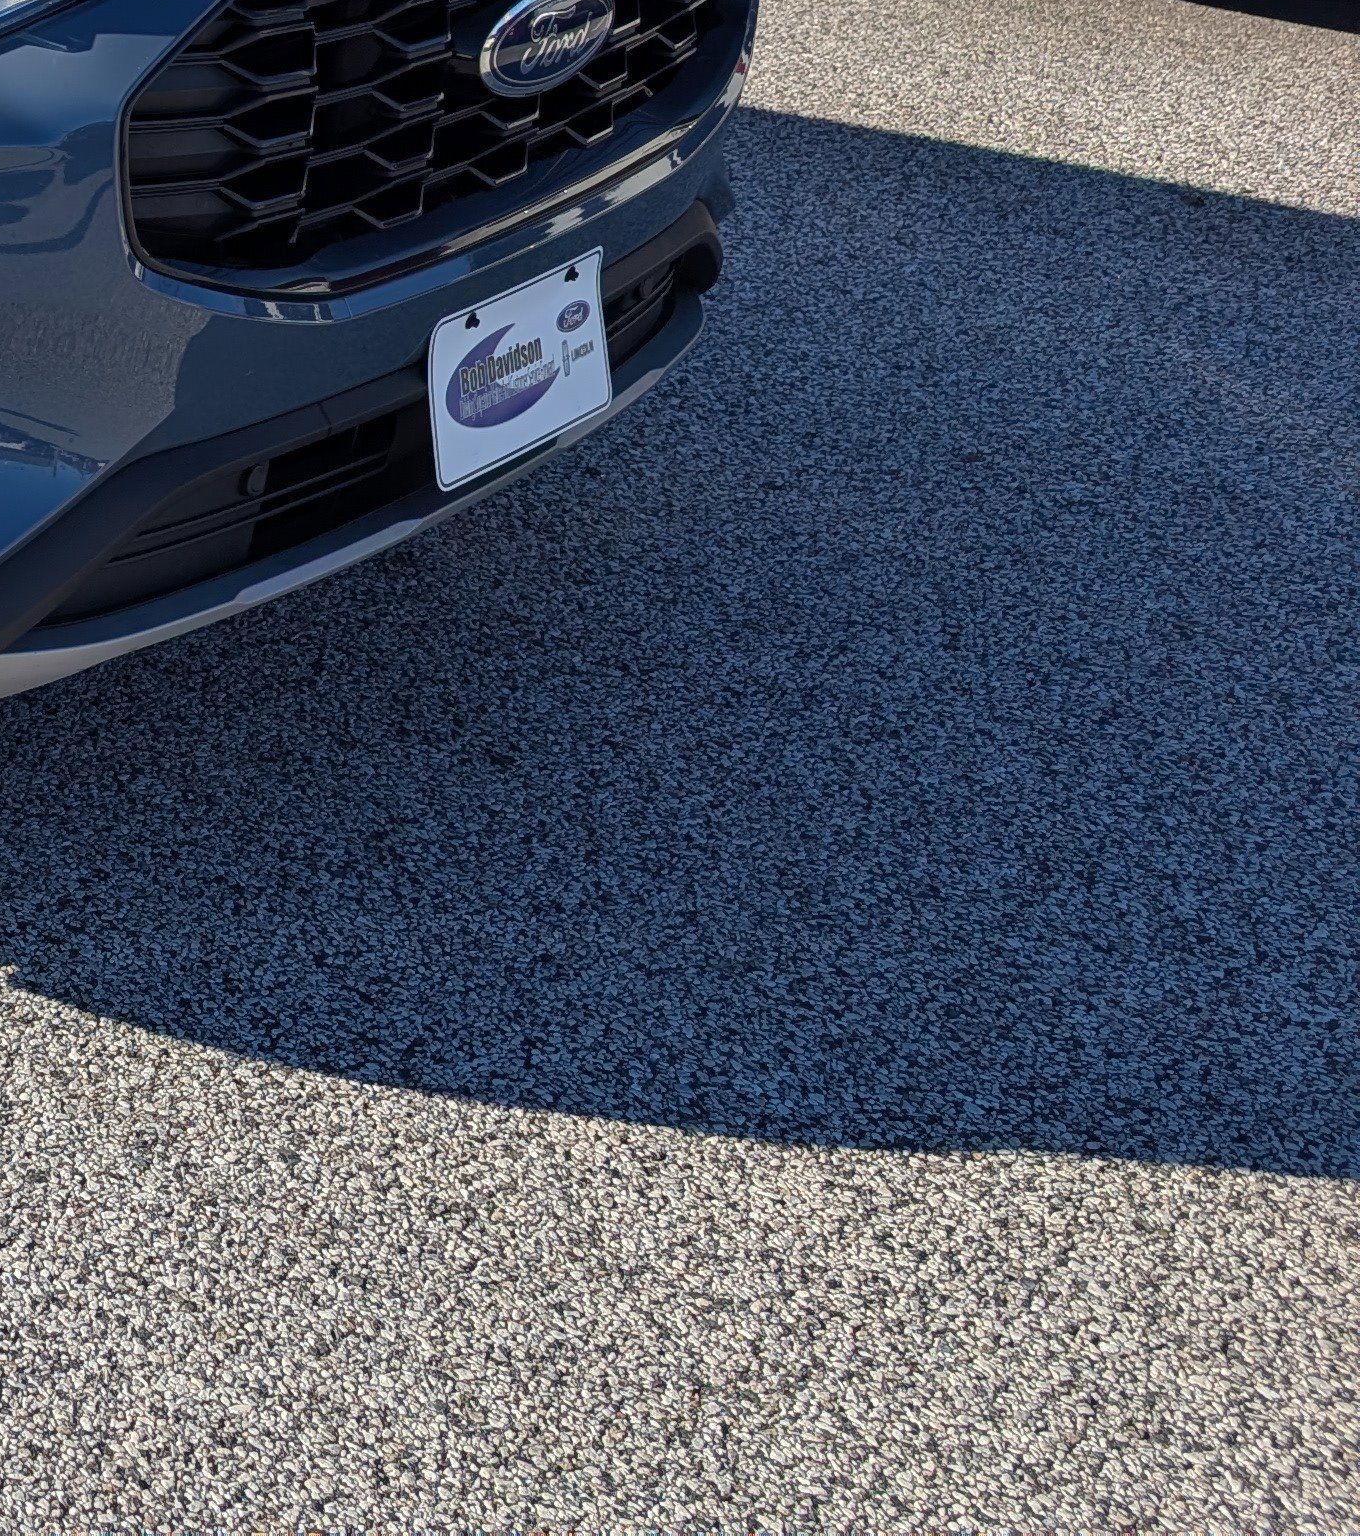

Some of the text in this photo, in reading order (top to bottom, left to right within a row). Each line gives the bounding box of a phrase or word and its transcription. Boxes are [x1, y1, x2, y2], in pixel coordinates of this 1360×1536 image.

[521, 4, 594, 75] Ford
[460, 360, 486, 397] Bob
[486, 337, 543, 384] Davidson
